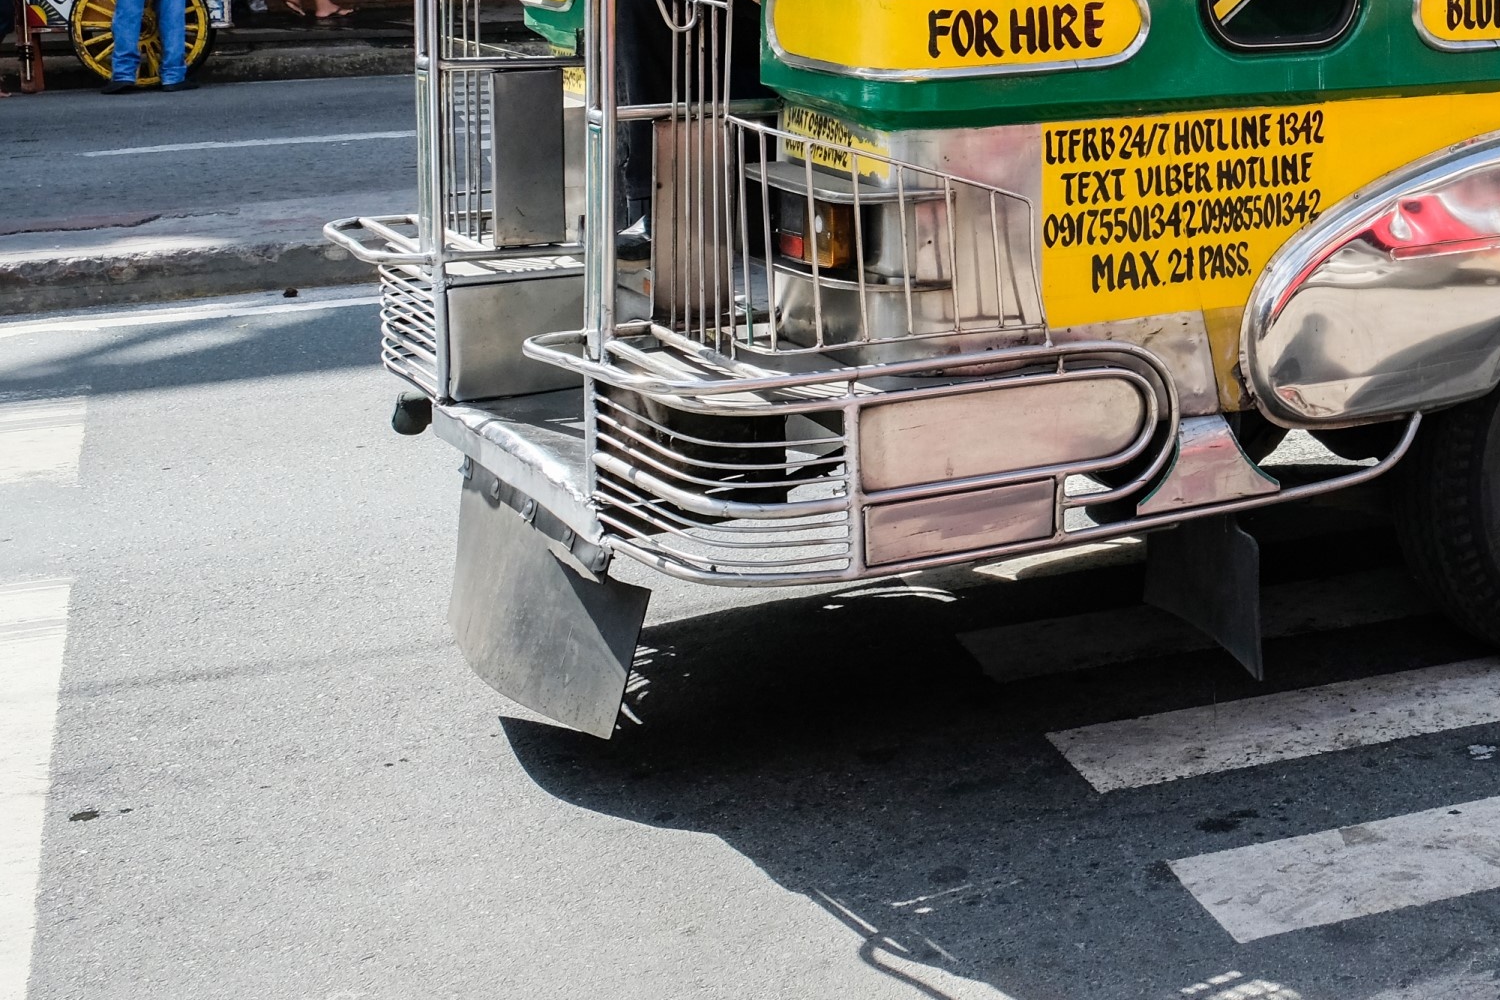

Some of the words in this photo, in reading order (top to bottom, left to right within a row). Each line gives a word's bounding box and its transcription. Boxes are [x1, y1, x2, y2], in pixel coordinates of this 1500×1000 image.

[928, 9, 1005, 58] FOR
[1010, 2, 1106, 55] HIRE
[1045, 127, 1116, 165] LTFRB
[1119, 123, 1171, 160] 24/7
[1174, 114, 1272, 155] HOTLINE
[1276, 110, 1324, 146] 1342
[1061, 168, 1126, 206] TEXT
[1135, 162, 1213, 198] VIBER
[1216, 152, 1314, 192] HOTLINE
[1092, 250, 1166, 293] MAX.
[1168, 247, 1194, 283] 21
[1198, 241, 1251, 281] PASS.
